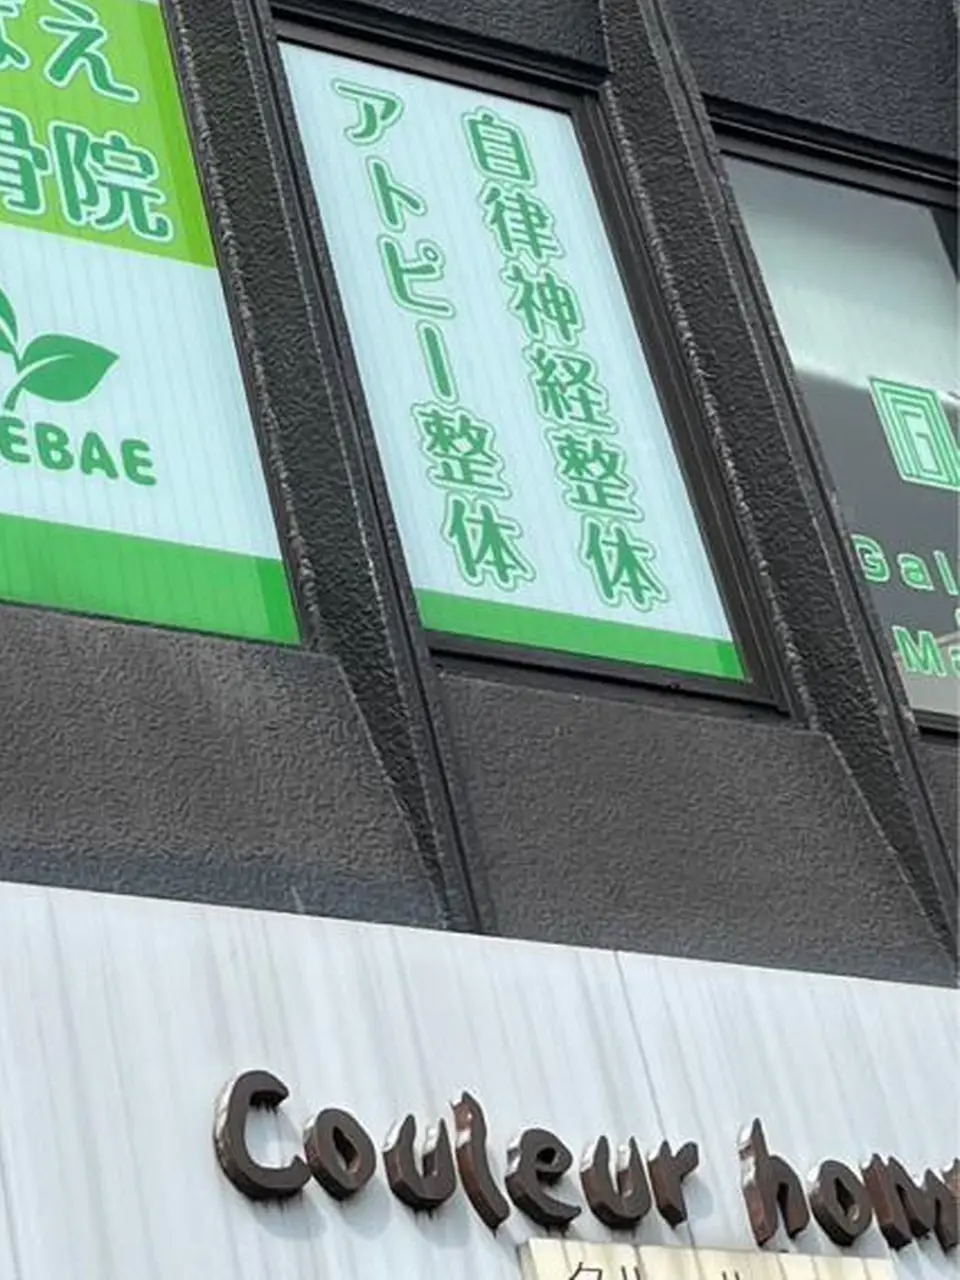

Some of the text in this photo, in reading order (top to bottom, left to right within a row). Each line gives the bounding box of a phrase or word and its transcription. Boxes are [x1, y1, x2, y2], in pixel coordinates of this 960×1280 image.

[332, 78, 537, 587] アトピー整体
[461, 105, 669, 613] 自律神経整体
[213, 1069, 700, 1231] Couleur
